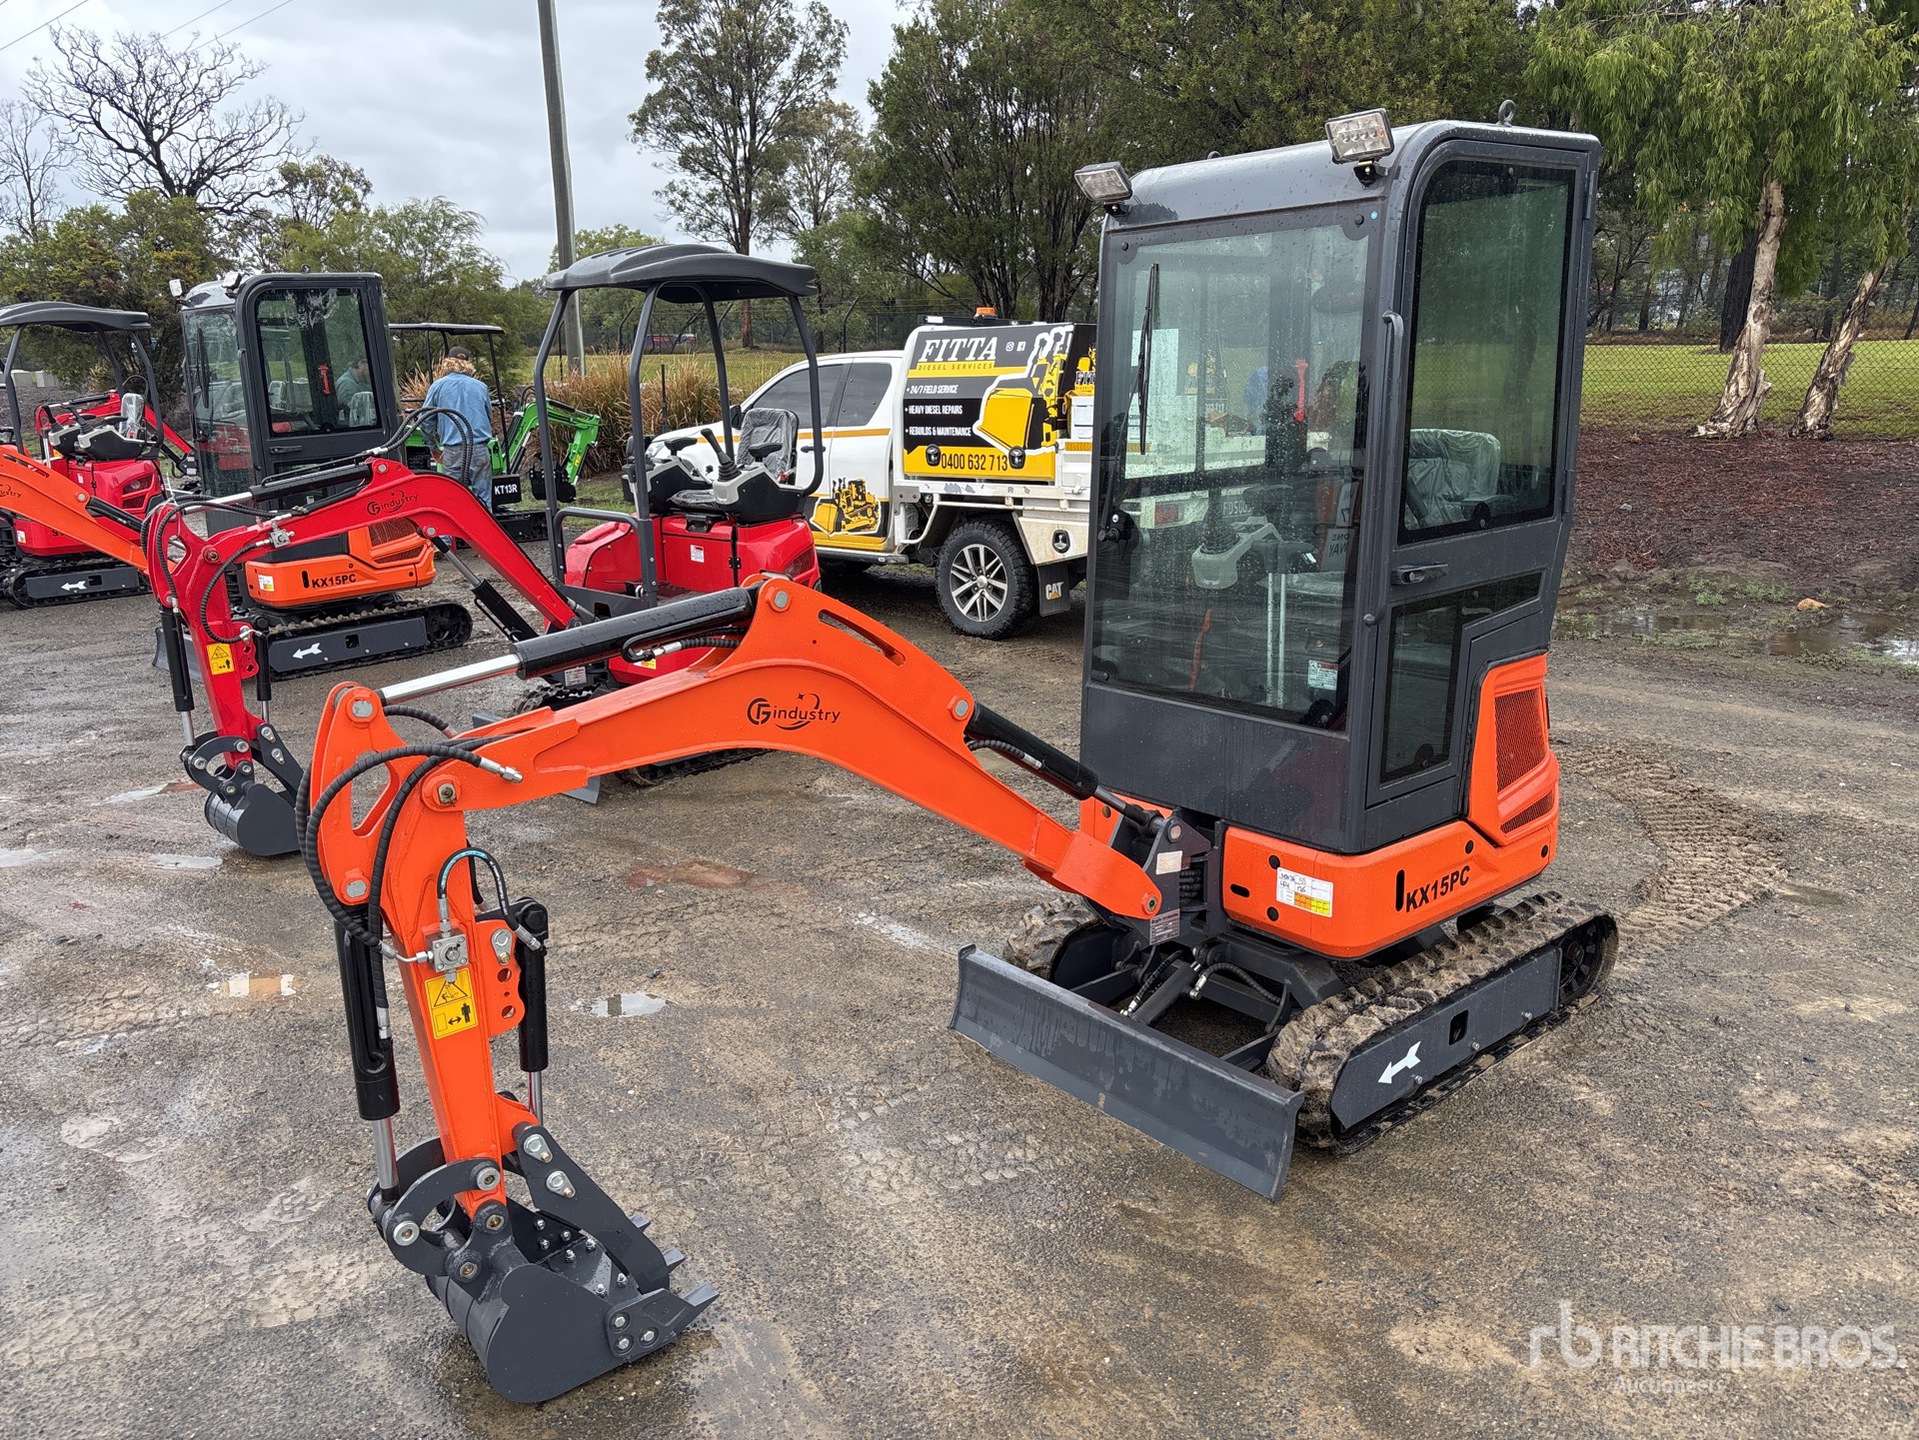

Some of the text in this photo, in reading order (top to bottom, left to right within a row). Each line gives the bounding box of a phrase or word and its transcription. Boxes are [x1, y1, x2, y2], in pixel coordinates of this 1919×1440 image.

[918, 336, 998, 362] FITTA
[951, 363, 993, 371] SERVICES
[909, 384, 959, 394] 24/7 FIELD SERVICE
[908, 405, 963, 415] HEAVY DIESEL REPAIRS
[909, 426, 931, 436] REBUILDS
[936, 426, 972, 437] MAINTENANCE
[941, 453, 1008, 472] 0400 632 713
[494, 484, 518, 496] KT13R
[381, 494, 419, 511] industry
[311, 573, 357, 588] KX15PC
[1045, 581, 1064, 600] CAT
[773, 705, 841, 723] industry
[1406, 865, 1470, 913] KX15PC
